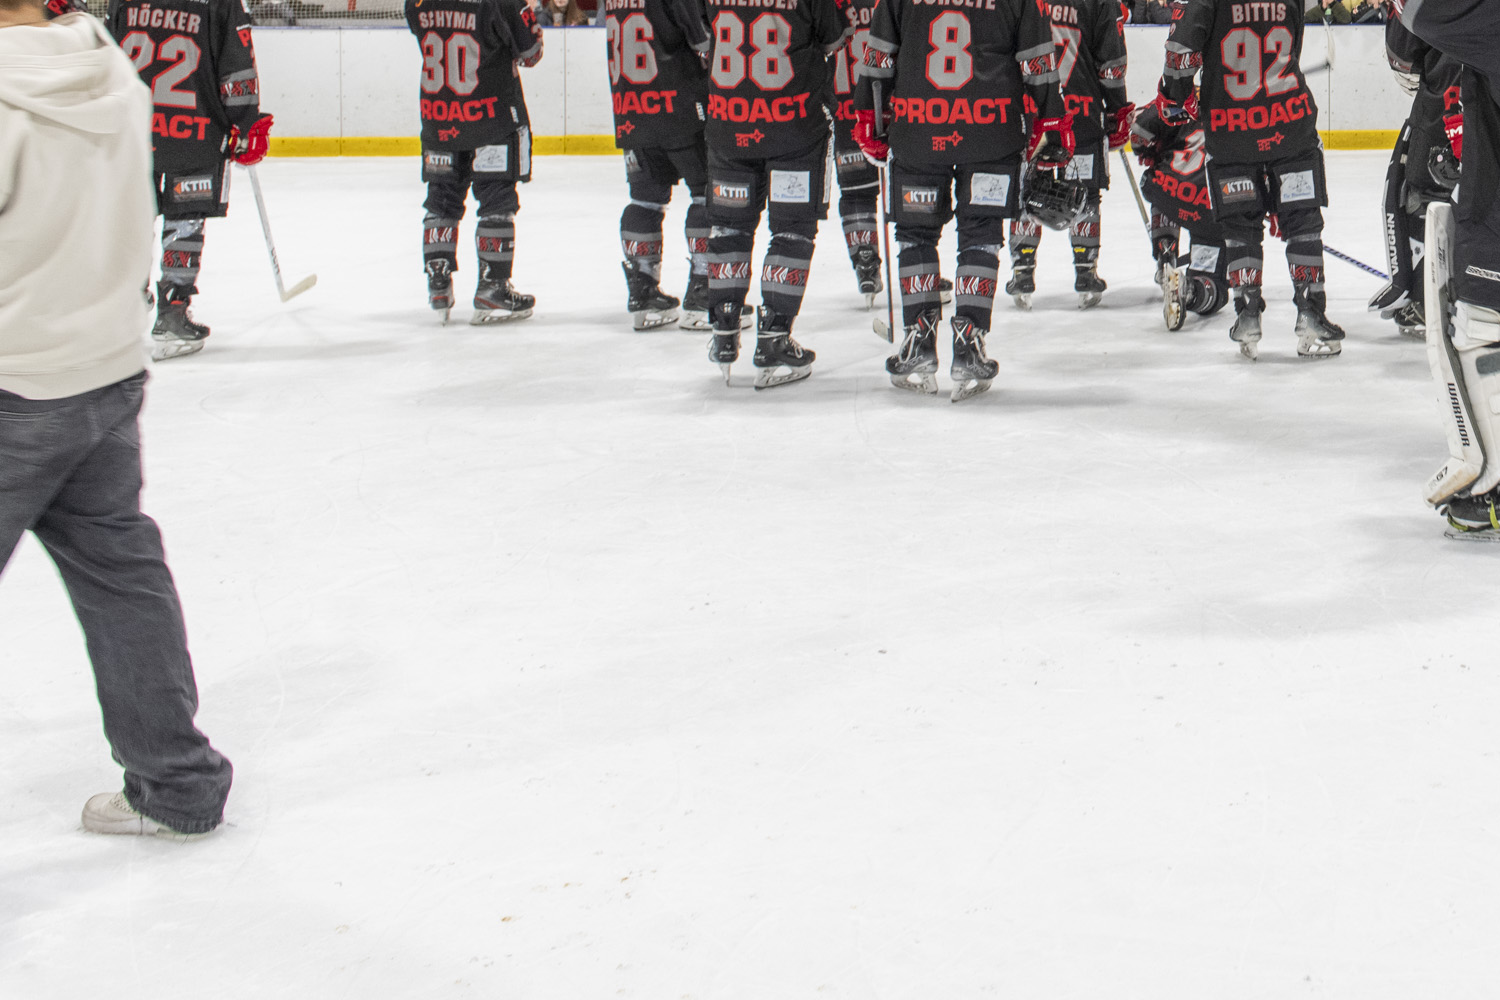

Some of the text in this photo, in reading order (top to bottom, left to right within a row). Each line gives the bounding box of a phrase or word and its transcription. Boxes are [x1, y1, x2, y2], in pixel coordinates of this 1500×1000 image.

[126, 3, 202, 34] HÖCKER
[1048, 3, 1078, 25] GIN
[1231, 2, 1287, 24] BITTIS
[421, 31, 480, 96] 30
[710, 10, 795, 91] 88
[926, 10, 973, 91] 8
[1220, 26, 1299, 100] 92
[892, 98, 1011, 124] PROACT
[1211, 92, 1313, 132] PROACT
[180, 179, 212, 193] KTM
[719, 184, 749, 199] KTM
[1227, 179, 1254, 195] KTM
[1386, 212, 1399, 275] VAUGHN
[1447, 382, 1470, 447] WARRIOR
